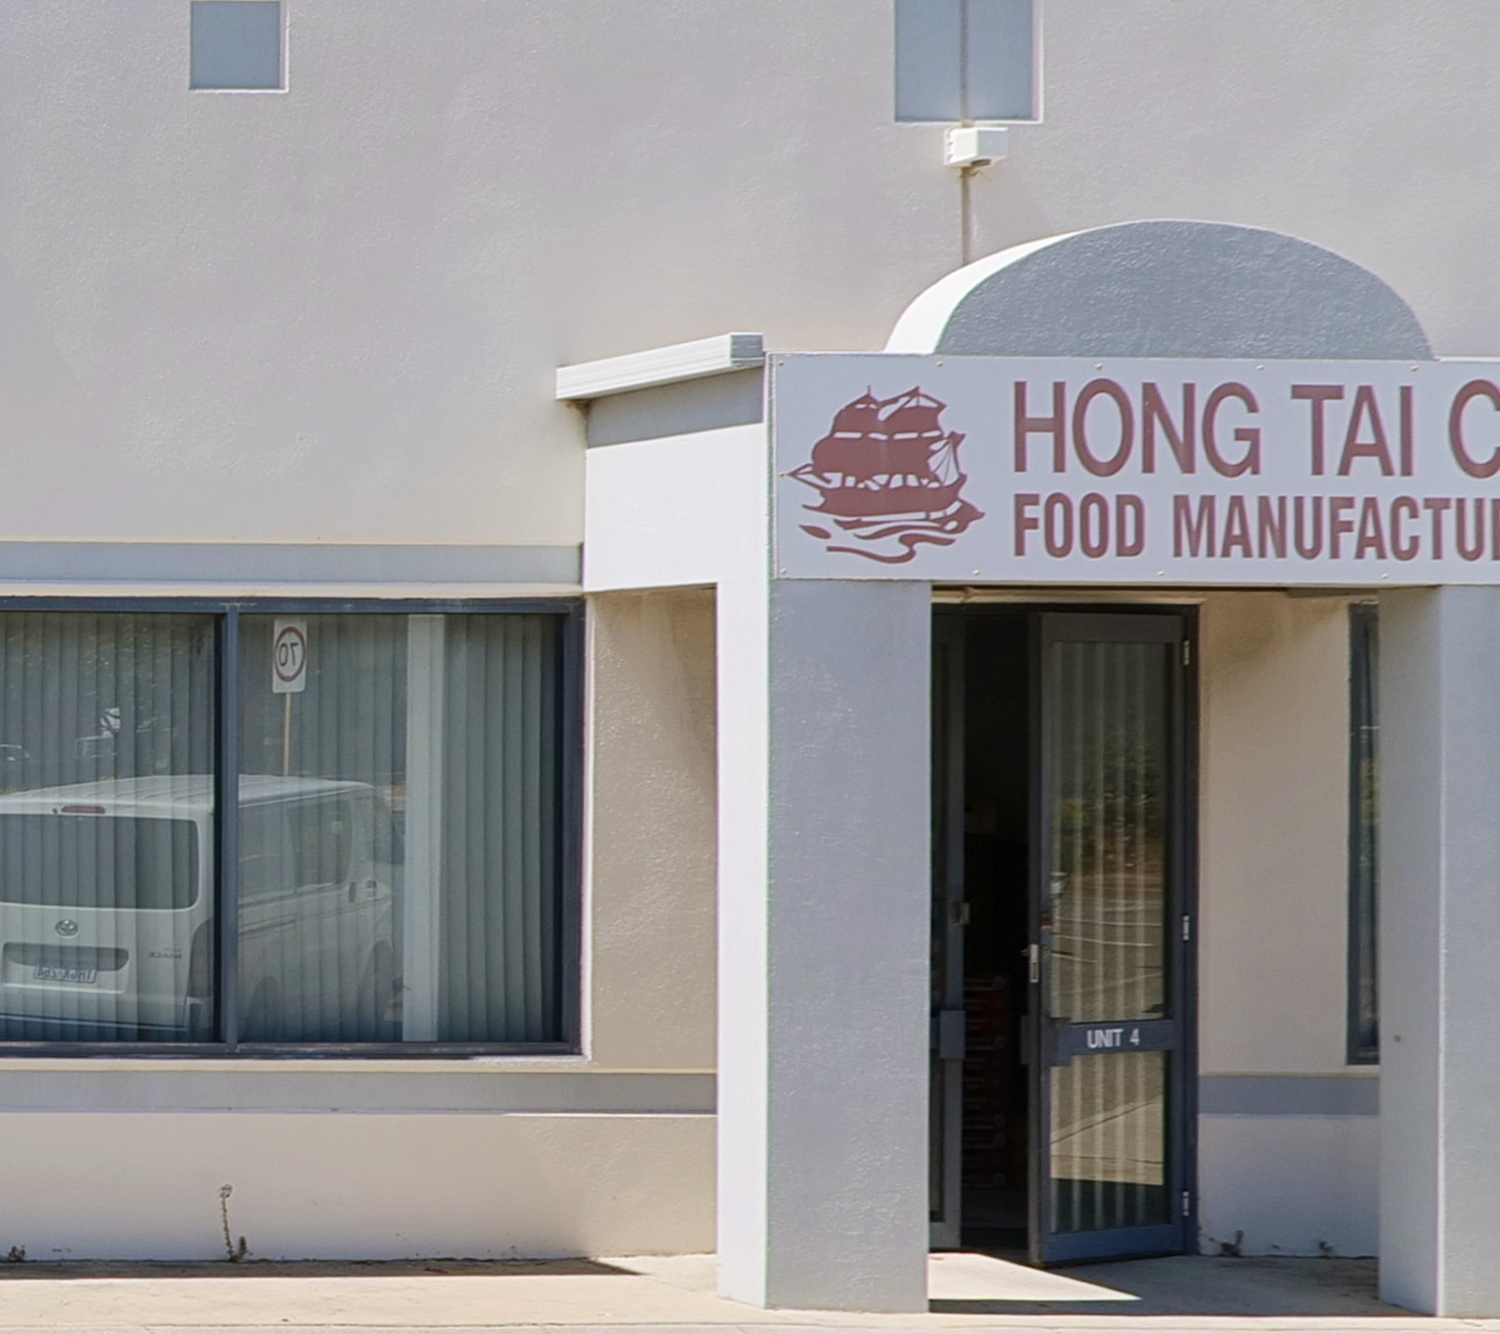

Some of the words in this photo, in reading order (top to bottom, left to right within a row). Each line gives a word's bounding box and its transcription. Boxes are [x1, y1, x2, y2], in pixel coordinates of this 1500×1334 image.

[1013, 378, 1262, 478] HONG
[1290, 384, 1414, 477] TAI
[1013, 492, 1146, 558] FOOD
[1172, 495, 1500, 561] MANUFACTU
[1086, 1028, 1124, 1048] UNIT
[1129, 1028, 1140, 1046] 4
